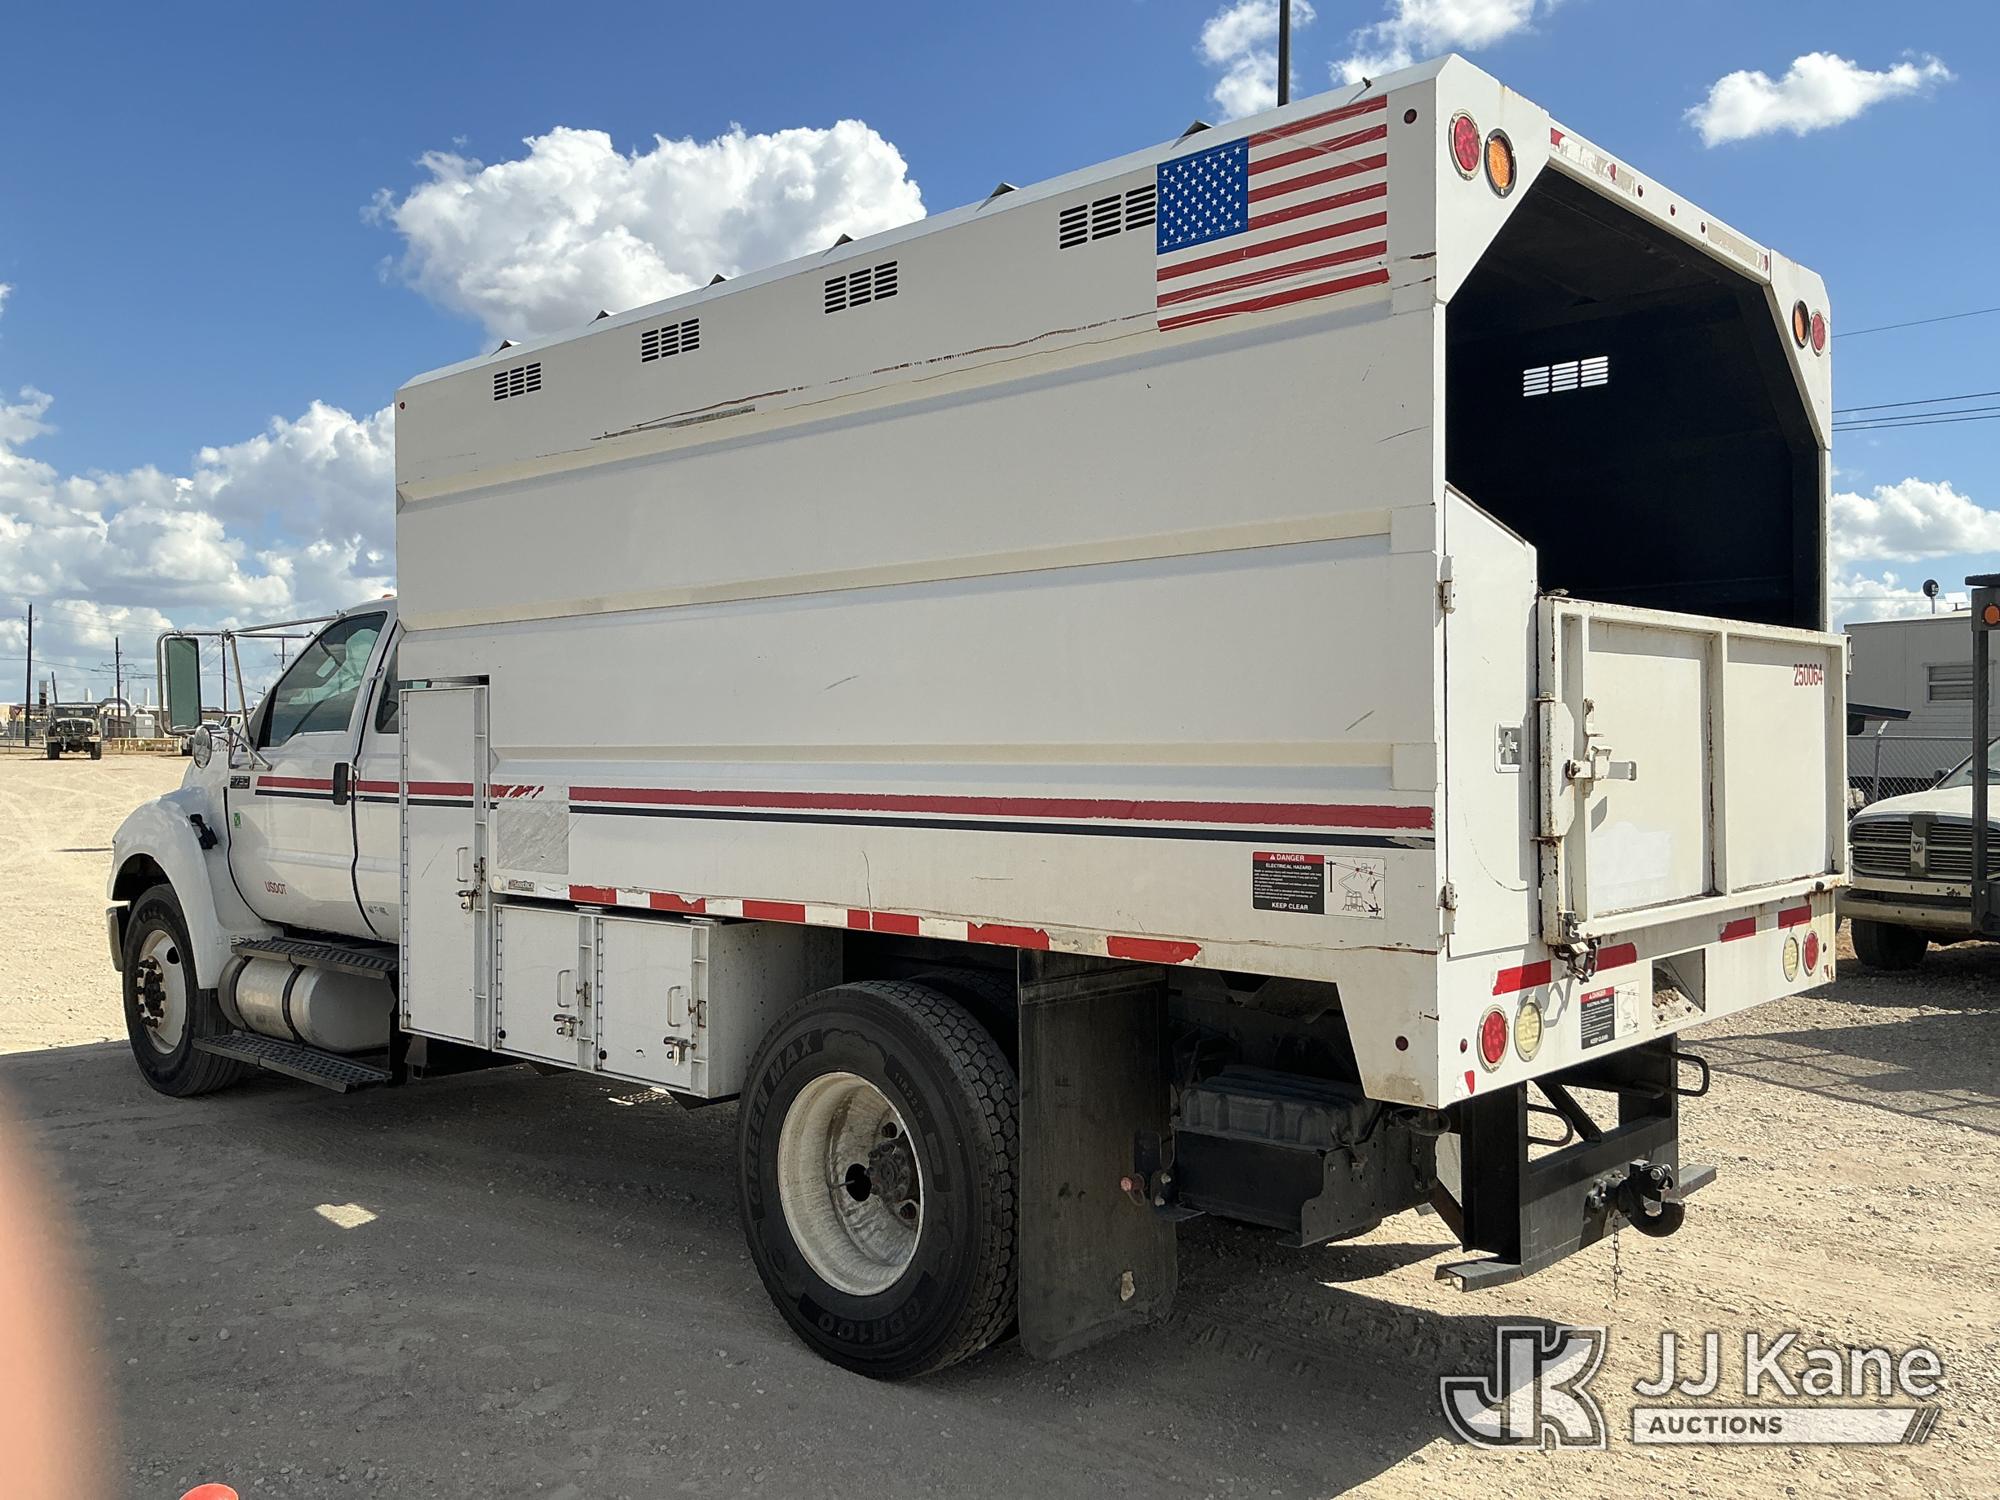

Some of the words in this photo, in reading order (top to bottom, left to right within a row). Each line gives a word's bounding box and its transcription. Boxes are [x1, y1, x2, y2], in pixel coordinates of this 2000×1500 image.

[1793, 663, 1823, 686] 250064
[264, 880, 287, 895] USDOT
[768, 1032, 812, 1091] MAX
